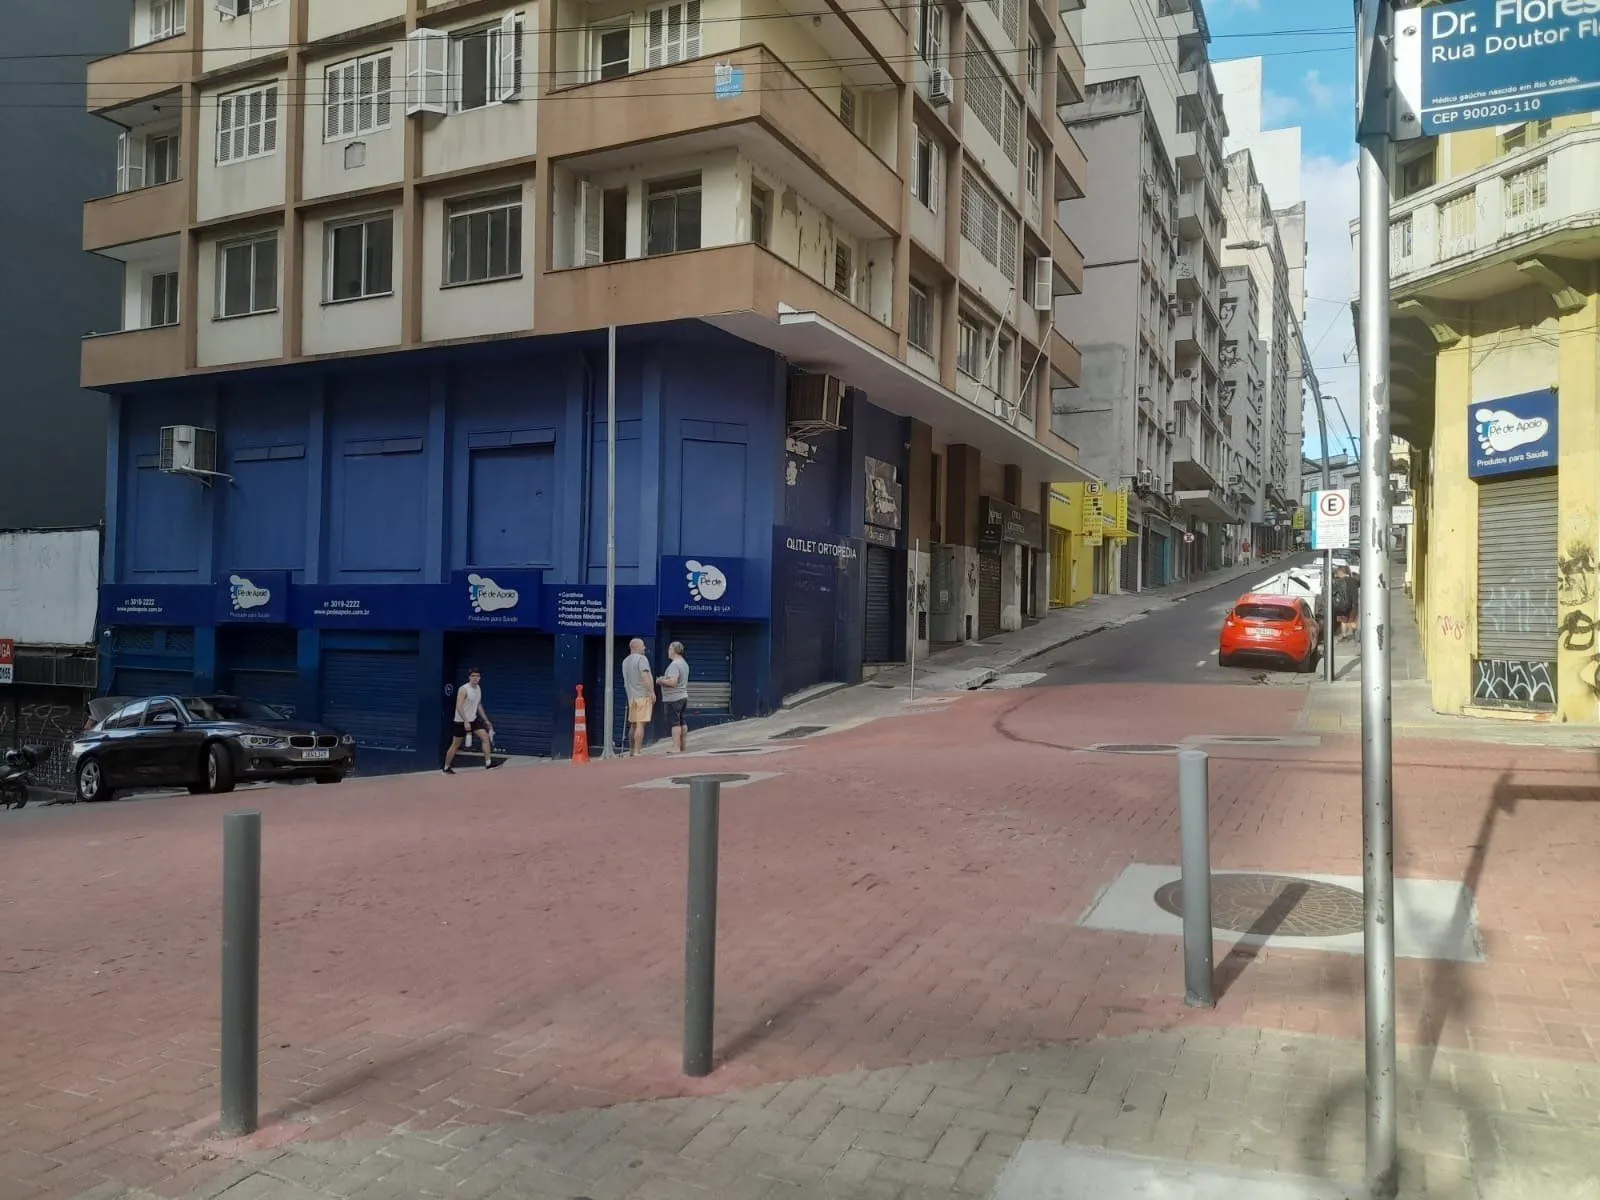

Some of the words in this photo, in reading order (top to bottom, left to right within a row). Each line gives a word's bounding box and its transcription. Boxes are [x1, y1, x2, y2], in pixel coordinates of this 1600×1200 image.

[1432, 11, 1477, 40] Dr.
[1432, 44, 1476, 63] Rua
[1485, 27, 1570, 54] Doutor
[1578, 18, 1600, 39] Fl
[1432, 96, 1457, 105] Médico
[1459, 91, 1487, 102] gaúcho
[1488, 86, 1518, 96] nascido
[1533, 81, 1546, 89] Rio
[1432, 112, 1459, 125] CEP
[1463, 99, 1541, 120] 90020-110
[1502, 423, 1514, 433] de
[1516, 420, 1542, 433] Apoio
[1476, 457, 1507, 467] Produtos
[1508, 454, 1525, 464] para
[1091, 483, 1097, 493] E
[1327, 498, 1337, 512] E
[817, 542, 857, 559] ORTOPEDIA
[496, 591, 515, 599] Apoio
[684, 603, 713, 611] Produtos
[0, 643, 11, 657] GA
